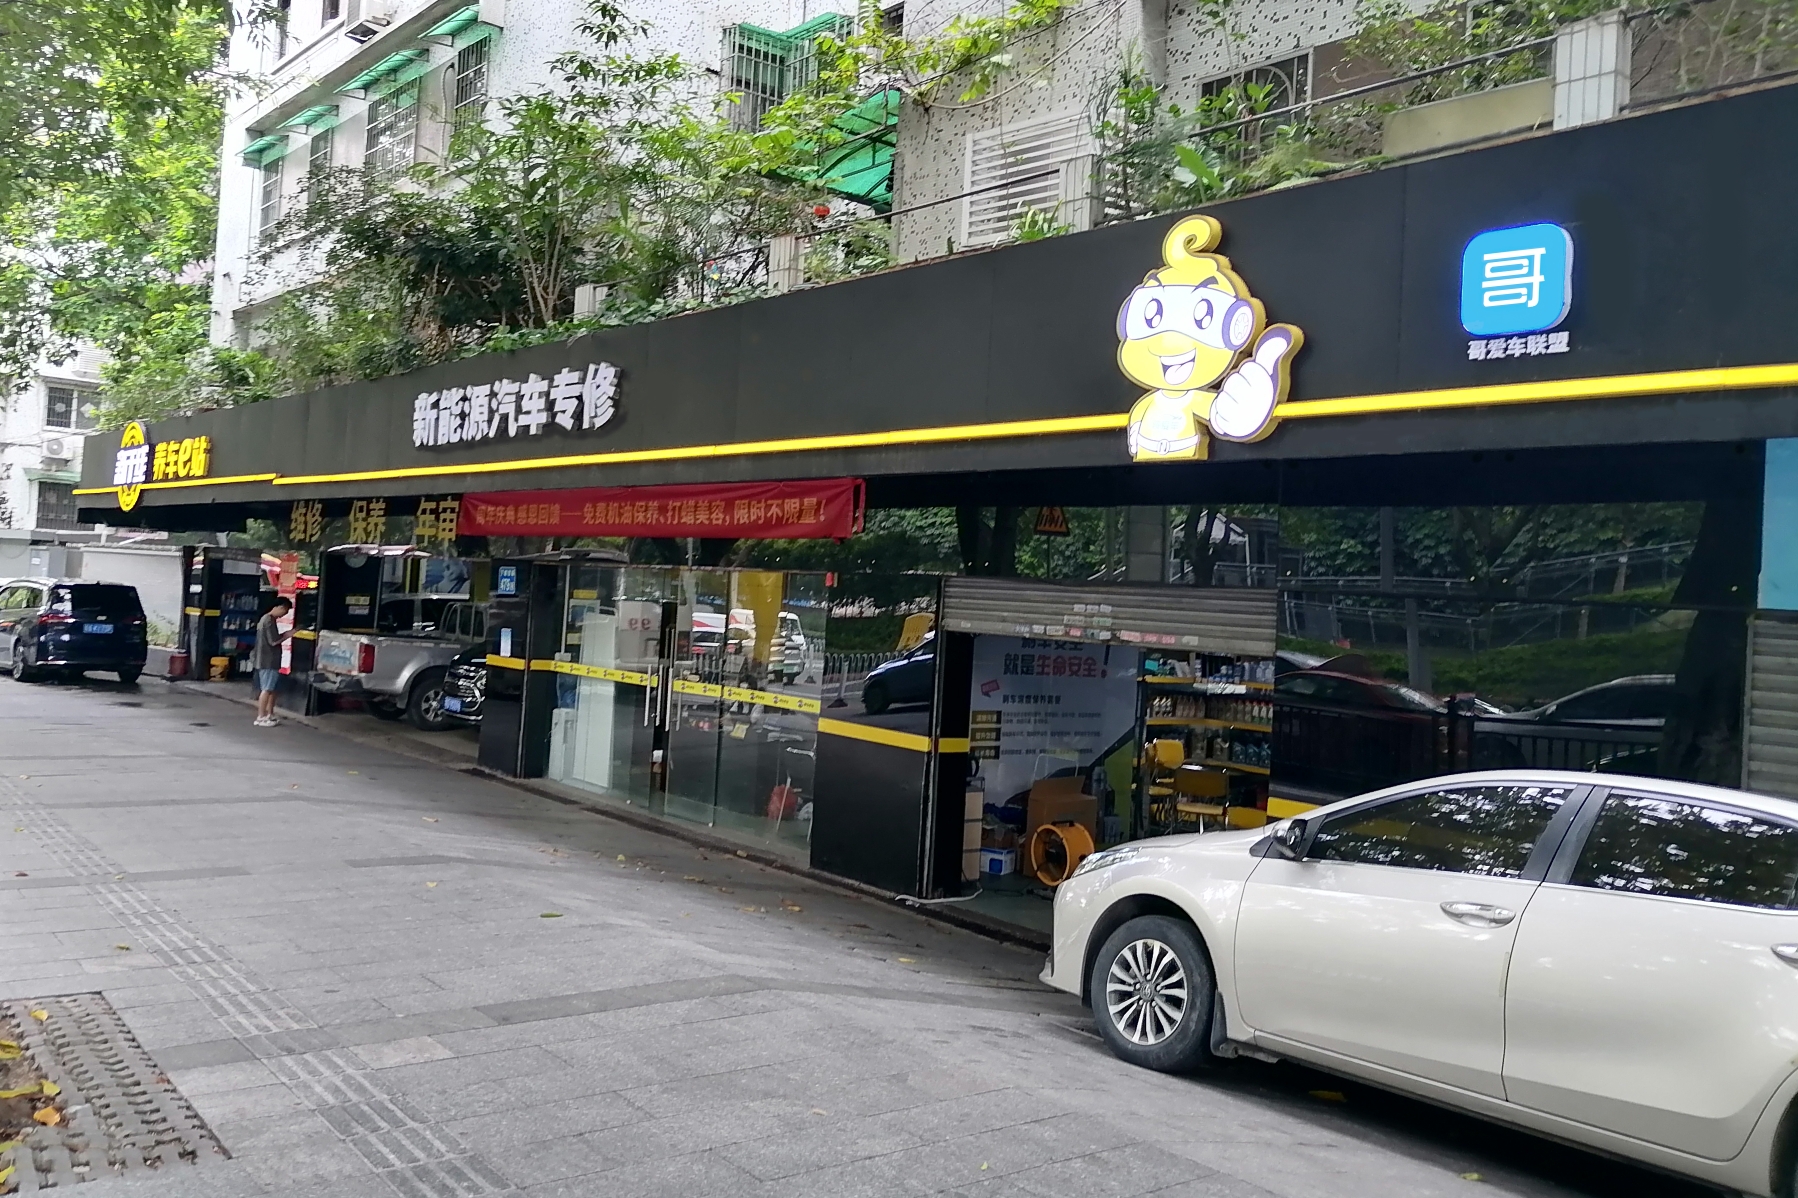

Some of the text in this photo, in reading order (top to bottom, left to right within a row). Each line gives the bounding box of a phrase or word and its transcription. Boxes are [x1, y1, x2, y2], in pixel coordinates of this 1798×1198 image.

[1481, 247, 1547, 308] 哥
[1467, 331, 1570, 361] 哥爱车联盟
[412, 361, 621, 447] 新能源汽车专修
[152, 435, 210, 481] 养车e站
[289, 496, 461, 547] 维修 保养 年审
